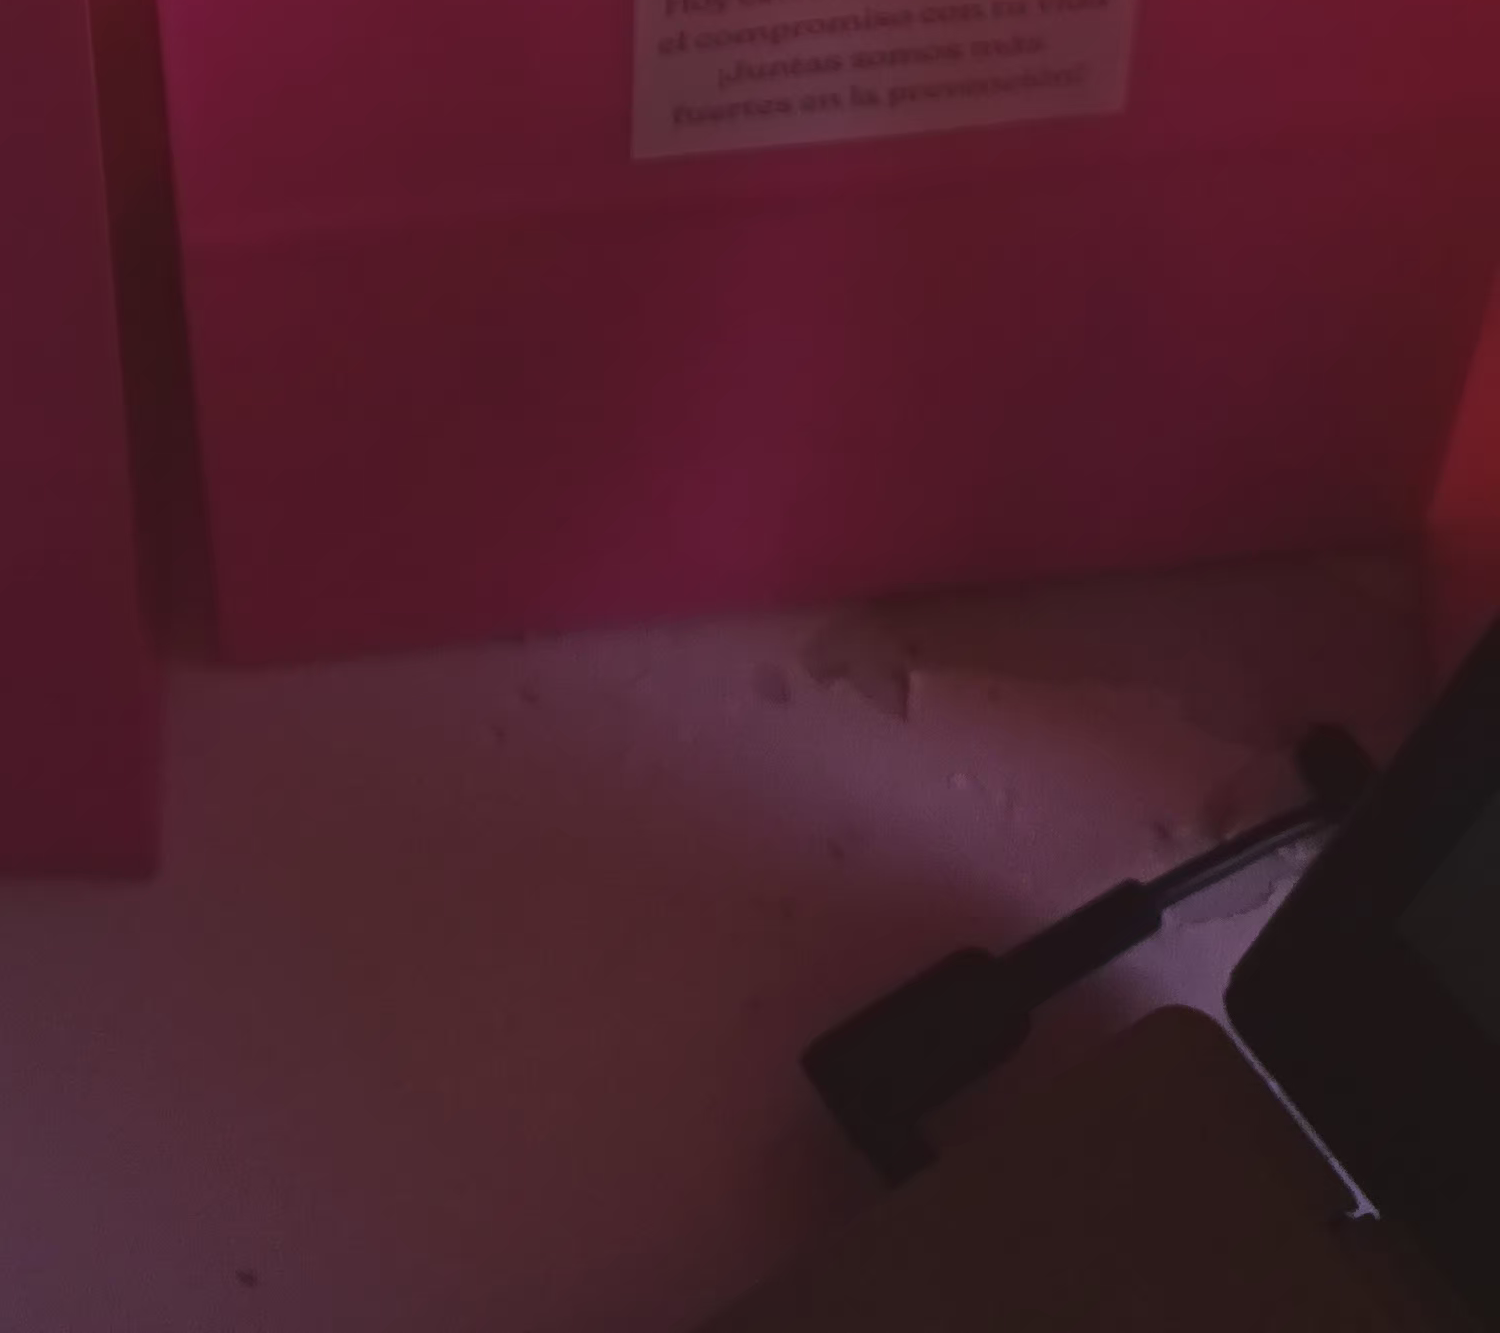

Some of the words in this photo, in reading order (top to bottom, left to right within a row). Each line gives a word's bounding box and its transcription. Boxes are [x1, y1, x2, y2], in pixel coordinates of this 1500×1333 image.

[658, 30, 688, 57] el
[694, 6, 913, 50] compromiso
[849, 43, 964, 70] somos
